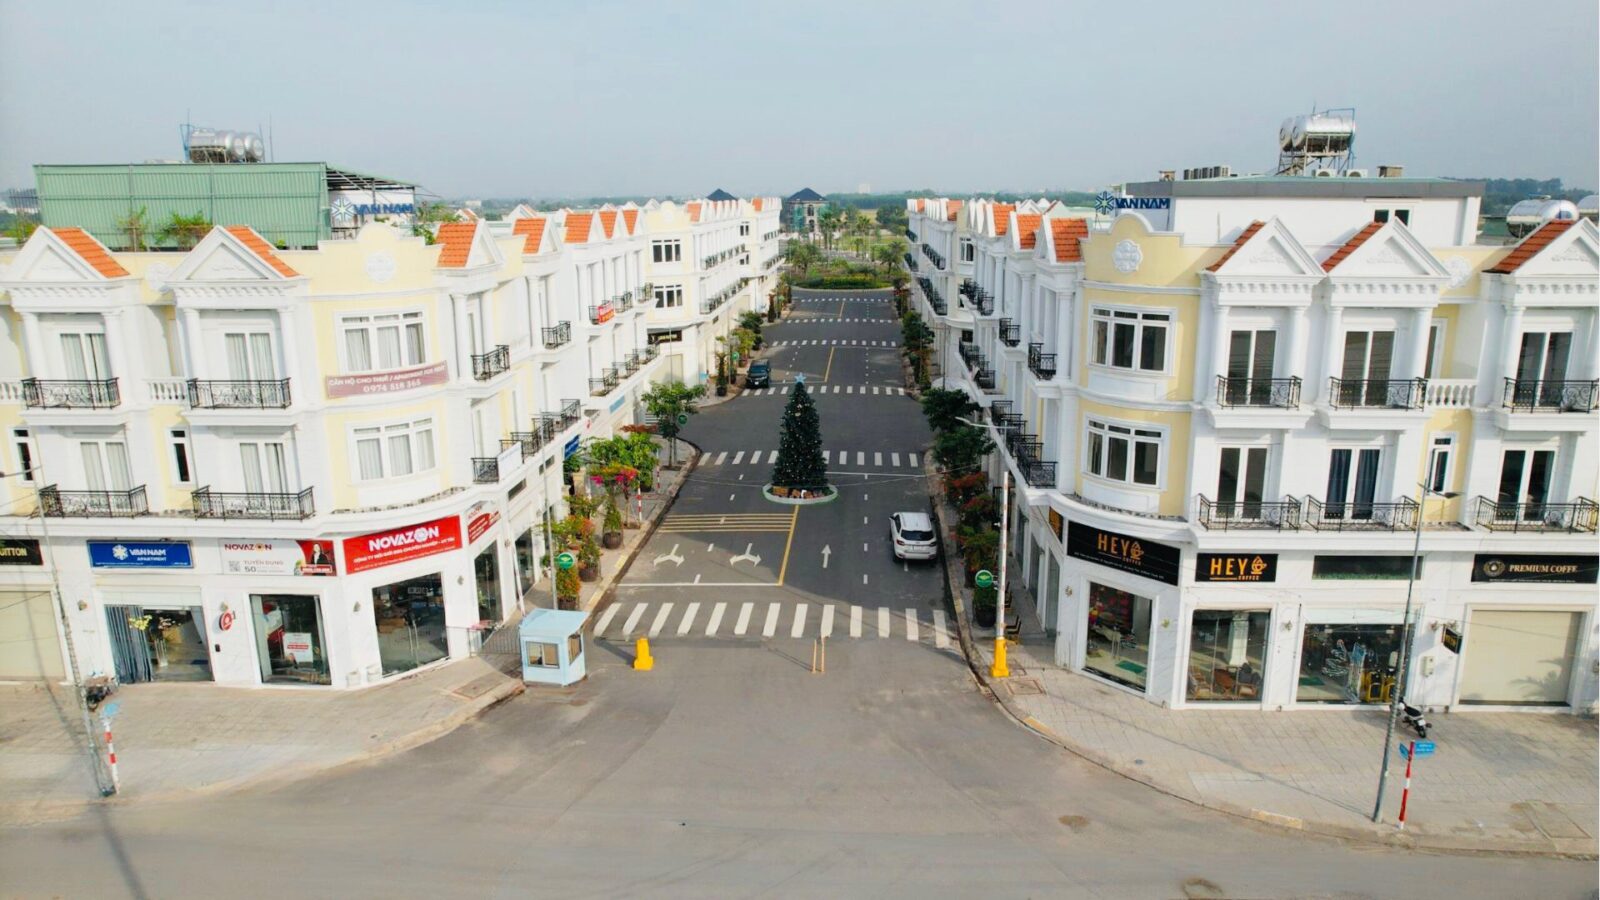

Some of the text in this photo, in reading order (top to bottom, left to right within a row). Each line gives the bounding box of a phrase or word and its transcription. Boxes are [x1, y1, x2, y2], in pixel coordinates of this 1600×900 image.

[383, 203, 413, 214] NAM
[1140, 198, 1170, 209] NAM
[368, 526, 439, 551] NOVAZON
[224, 543, 272, 552] NOVAZON
[1097, 533, 1130, 557] HEY
[1210, 558, 1248, 576] HEY
[1509, 564, 1549, 573] PREMIUM
